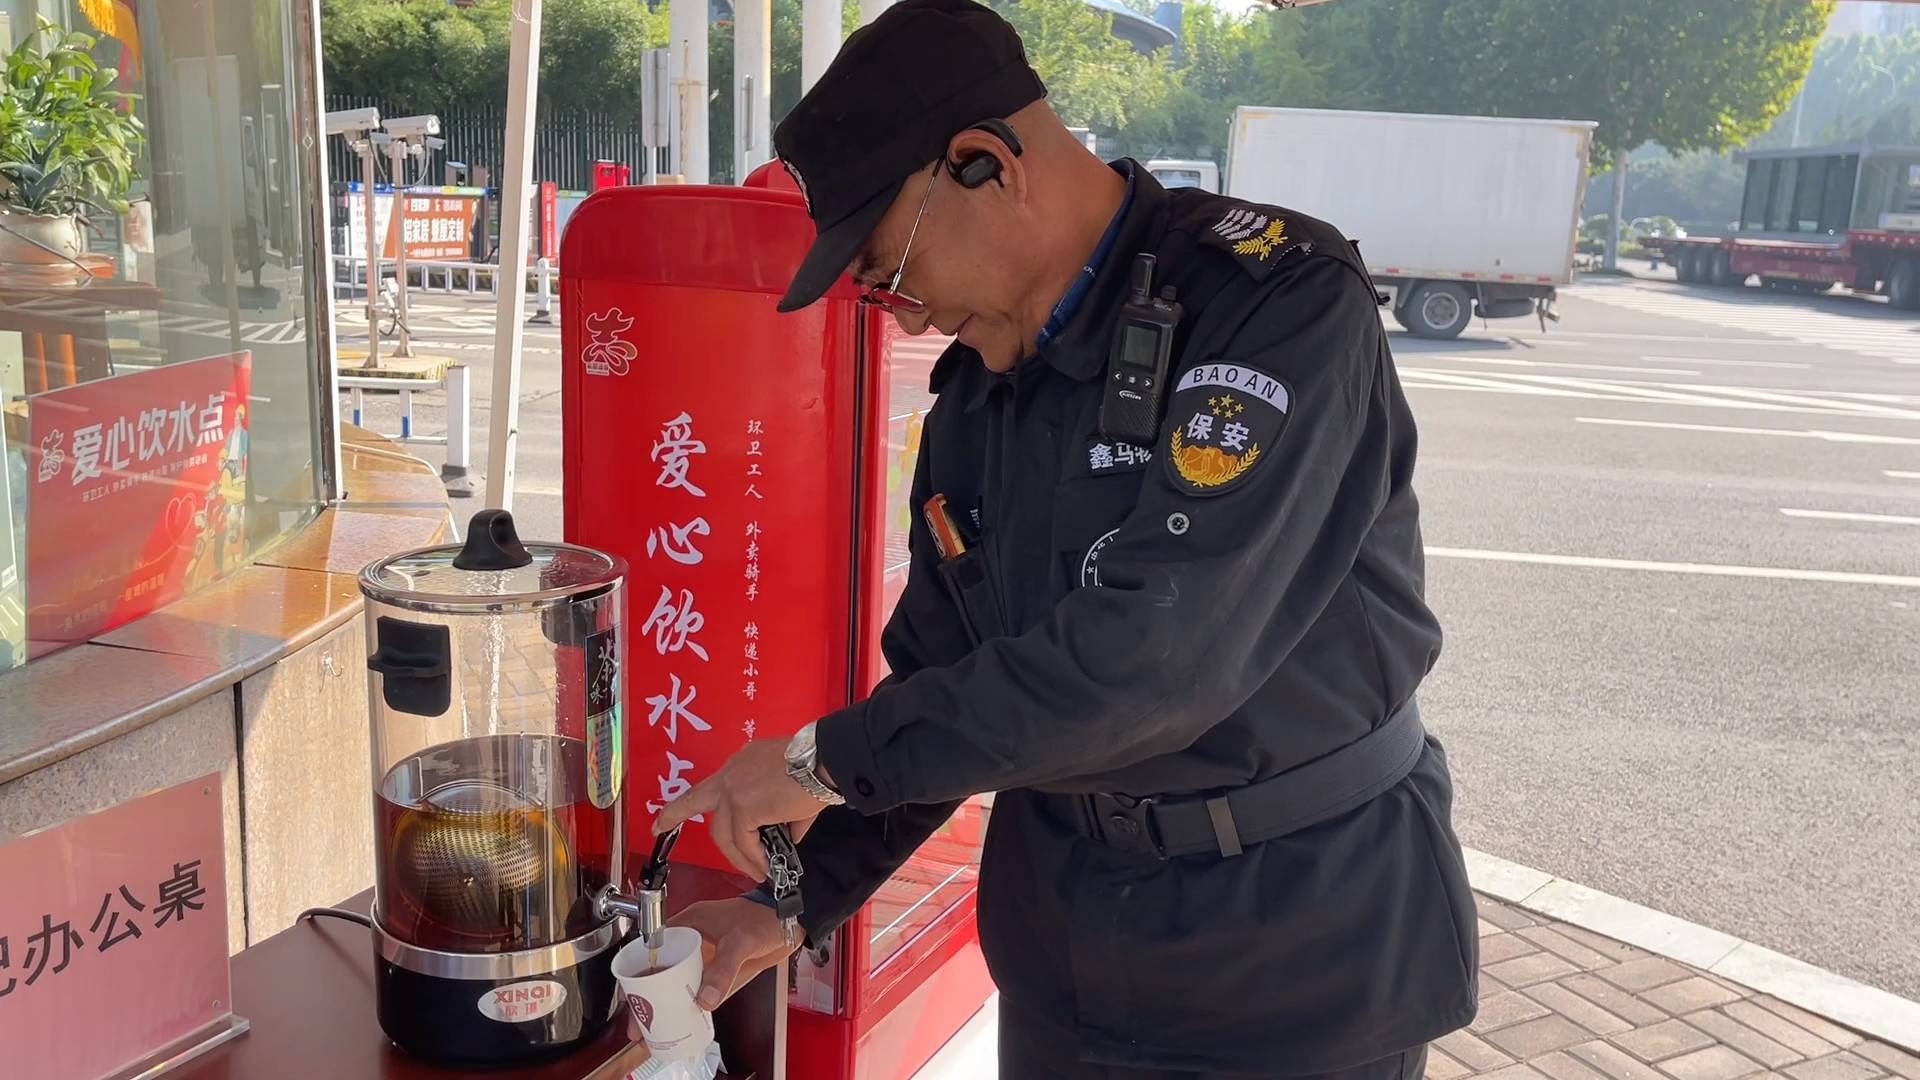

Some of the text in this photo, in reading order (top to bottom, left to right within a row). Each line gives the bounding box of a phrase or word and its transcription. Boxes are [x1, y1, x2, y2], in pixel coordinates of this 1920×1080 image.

[71, 394, 225, 486] 爱心饮水点
[744, 419, 764, 500] 环卫工人
[1187, 412, 1250, 451] 保安
[743, 520, 762, 602] 外卖骑手
[642, 411, 712, 823] 爱心饮水点
[741, 622, 760, 701] 快递小哥
[494, 983, 551, 1004] XINQI
